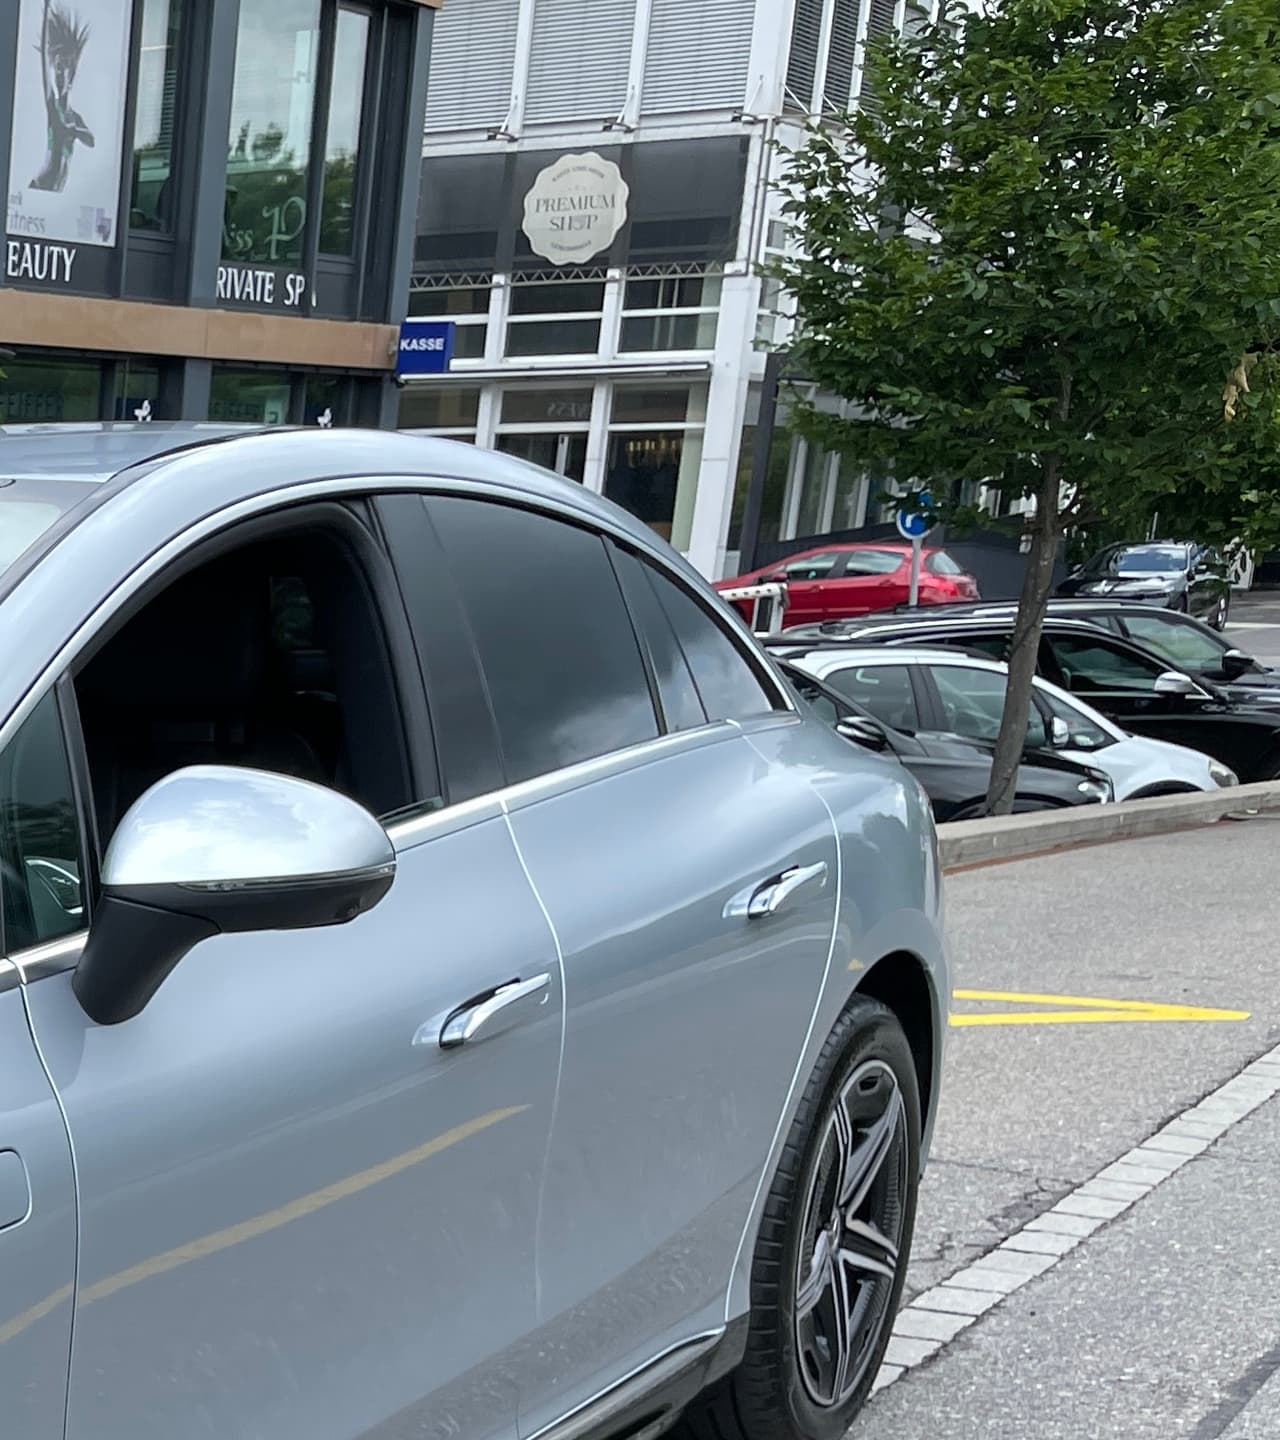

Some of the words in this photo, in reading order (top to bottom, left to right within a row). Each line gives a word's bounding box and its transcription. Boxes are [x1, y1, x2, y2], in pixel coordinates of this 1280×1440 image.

[535, 194, 616, 213] PREMIUM
[6, 241, 77, 282] EAUTY
[400, 337, 445, 351] KASSE
